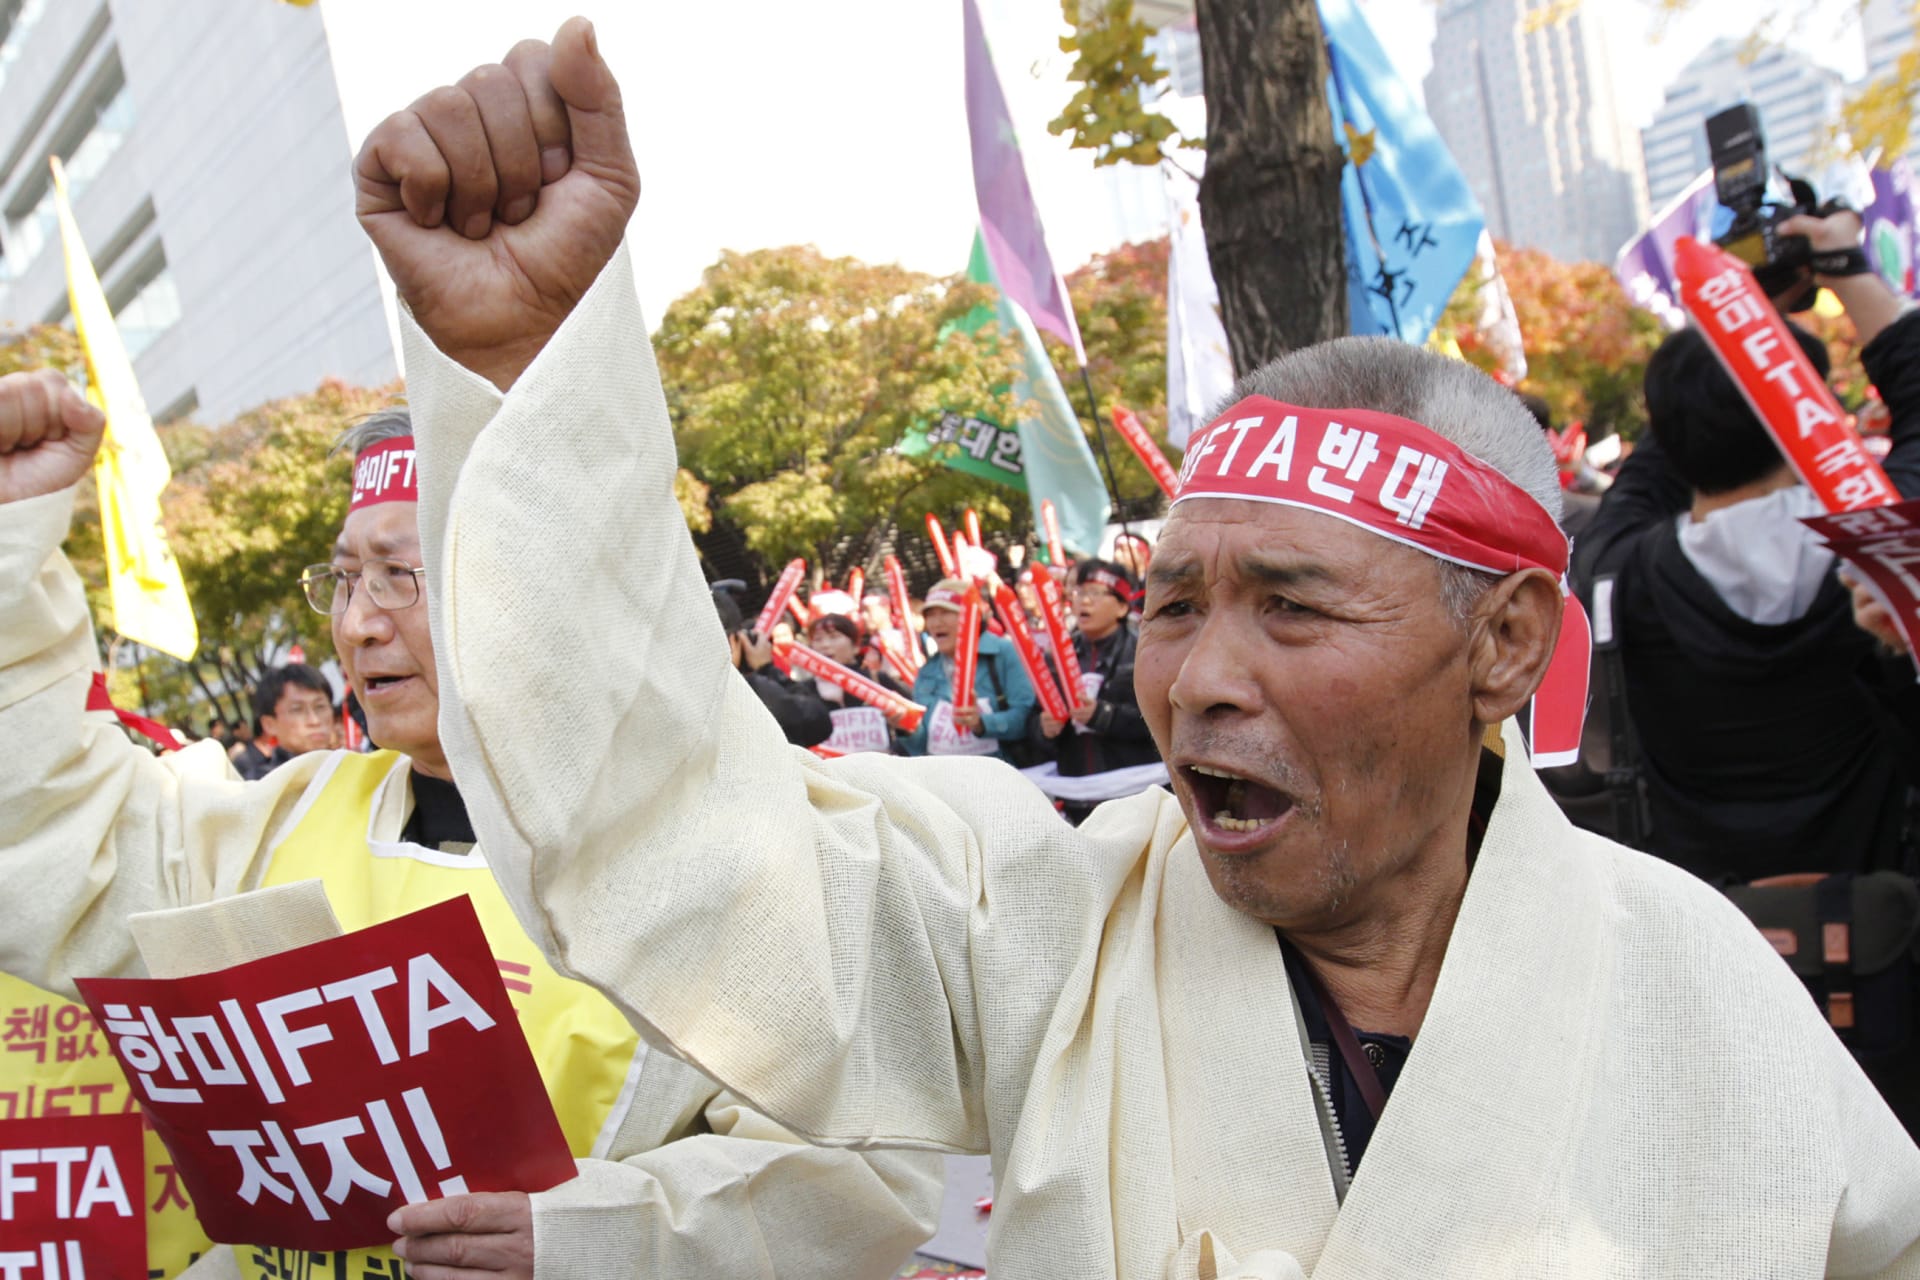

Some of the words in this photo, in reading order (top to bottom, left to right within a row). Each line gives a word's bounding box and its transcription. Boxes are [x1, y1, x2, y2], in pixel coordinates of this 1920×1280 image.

[351, 450, 418, 504] 한미FT
[1175, 415, 1298, 495] 미FTA
[1307, 421, 1449, 530] 반대
[1815, 438, 1898, 511] 국회
[2, 1003, 115, 1064] 책없
[103, 952, 497, 1104] 한미FTA
[0, 1145, 134, 1220] FTA
[207, 1086, 471, 1222] 저지!
